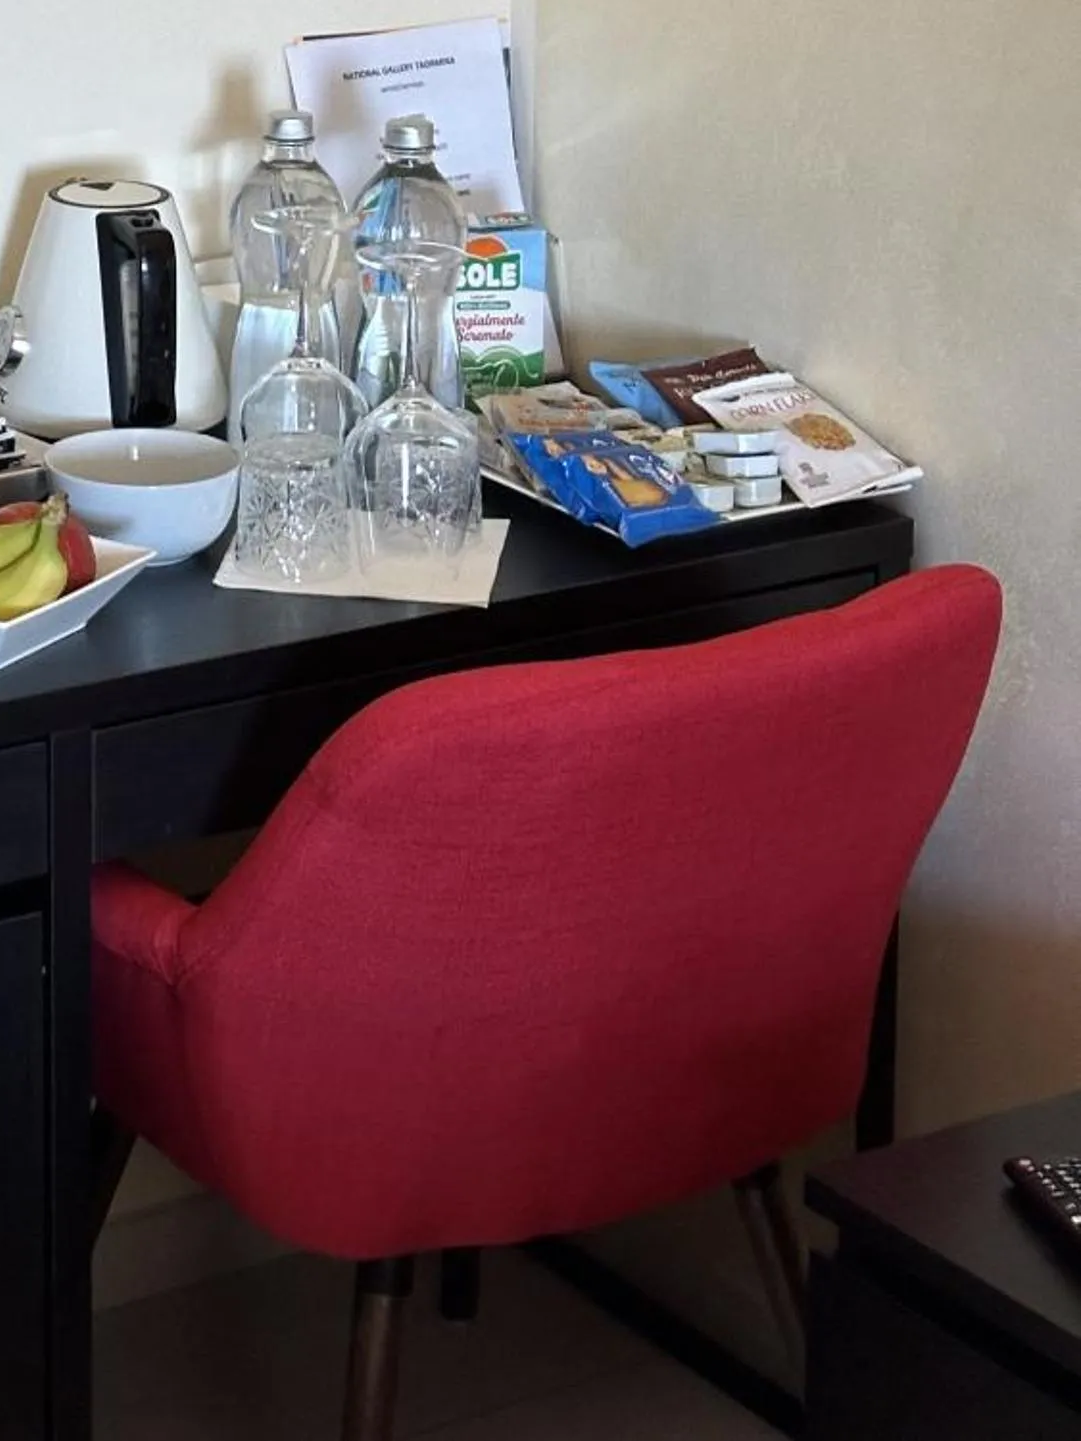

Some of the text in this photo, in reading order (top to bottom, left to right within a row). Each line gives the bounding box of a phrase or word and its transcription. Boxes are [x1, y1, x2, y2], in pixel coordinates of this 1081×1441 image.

[342, 68, 381, 80] NATIONAL
[382, 62, 413, 75] GALLERY
[456, 263, 517, 288] SOLE
